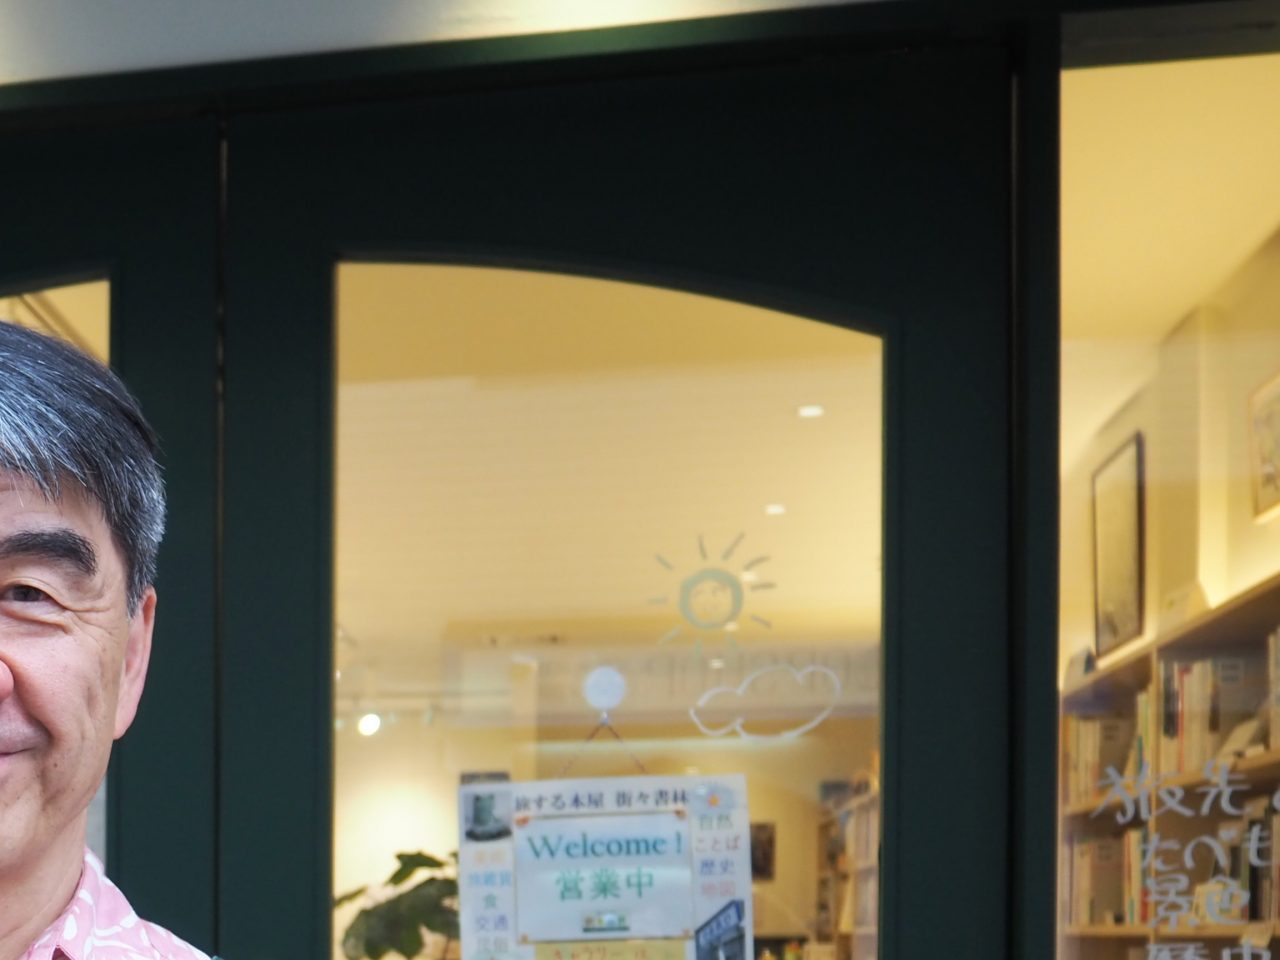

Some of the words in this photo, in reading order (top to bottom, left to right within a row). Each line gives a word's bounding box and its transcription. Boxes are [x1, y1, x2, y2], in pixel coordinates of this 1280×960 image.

[1089, 760, 1280, 825] 旅先
[554, 866, 655, 902] 営業中
